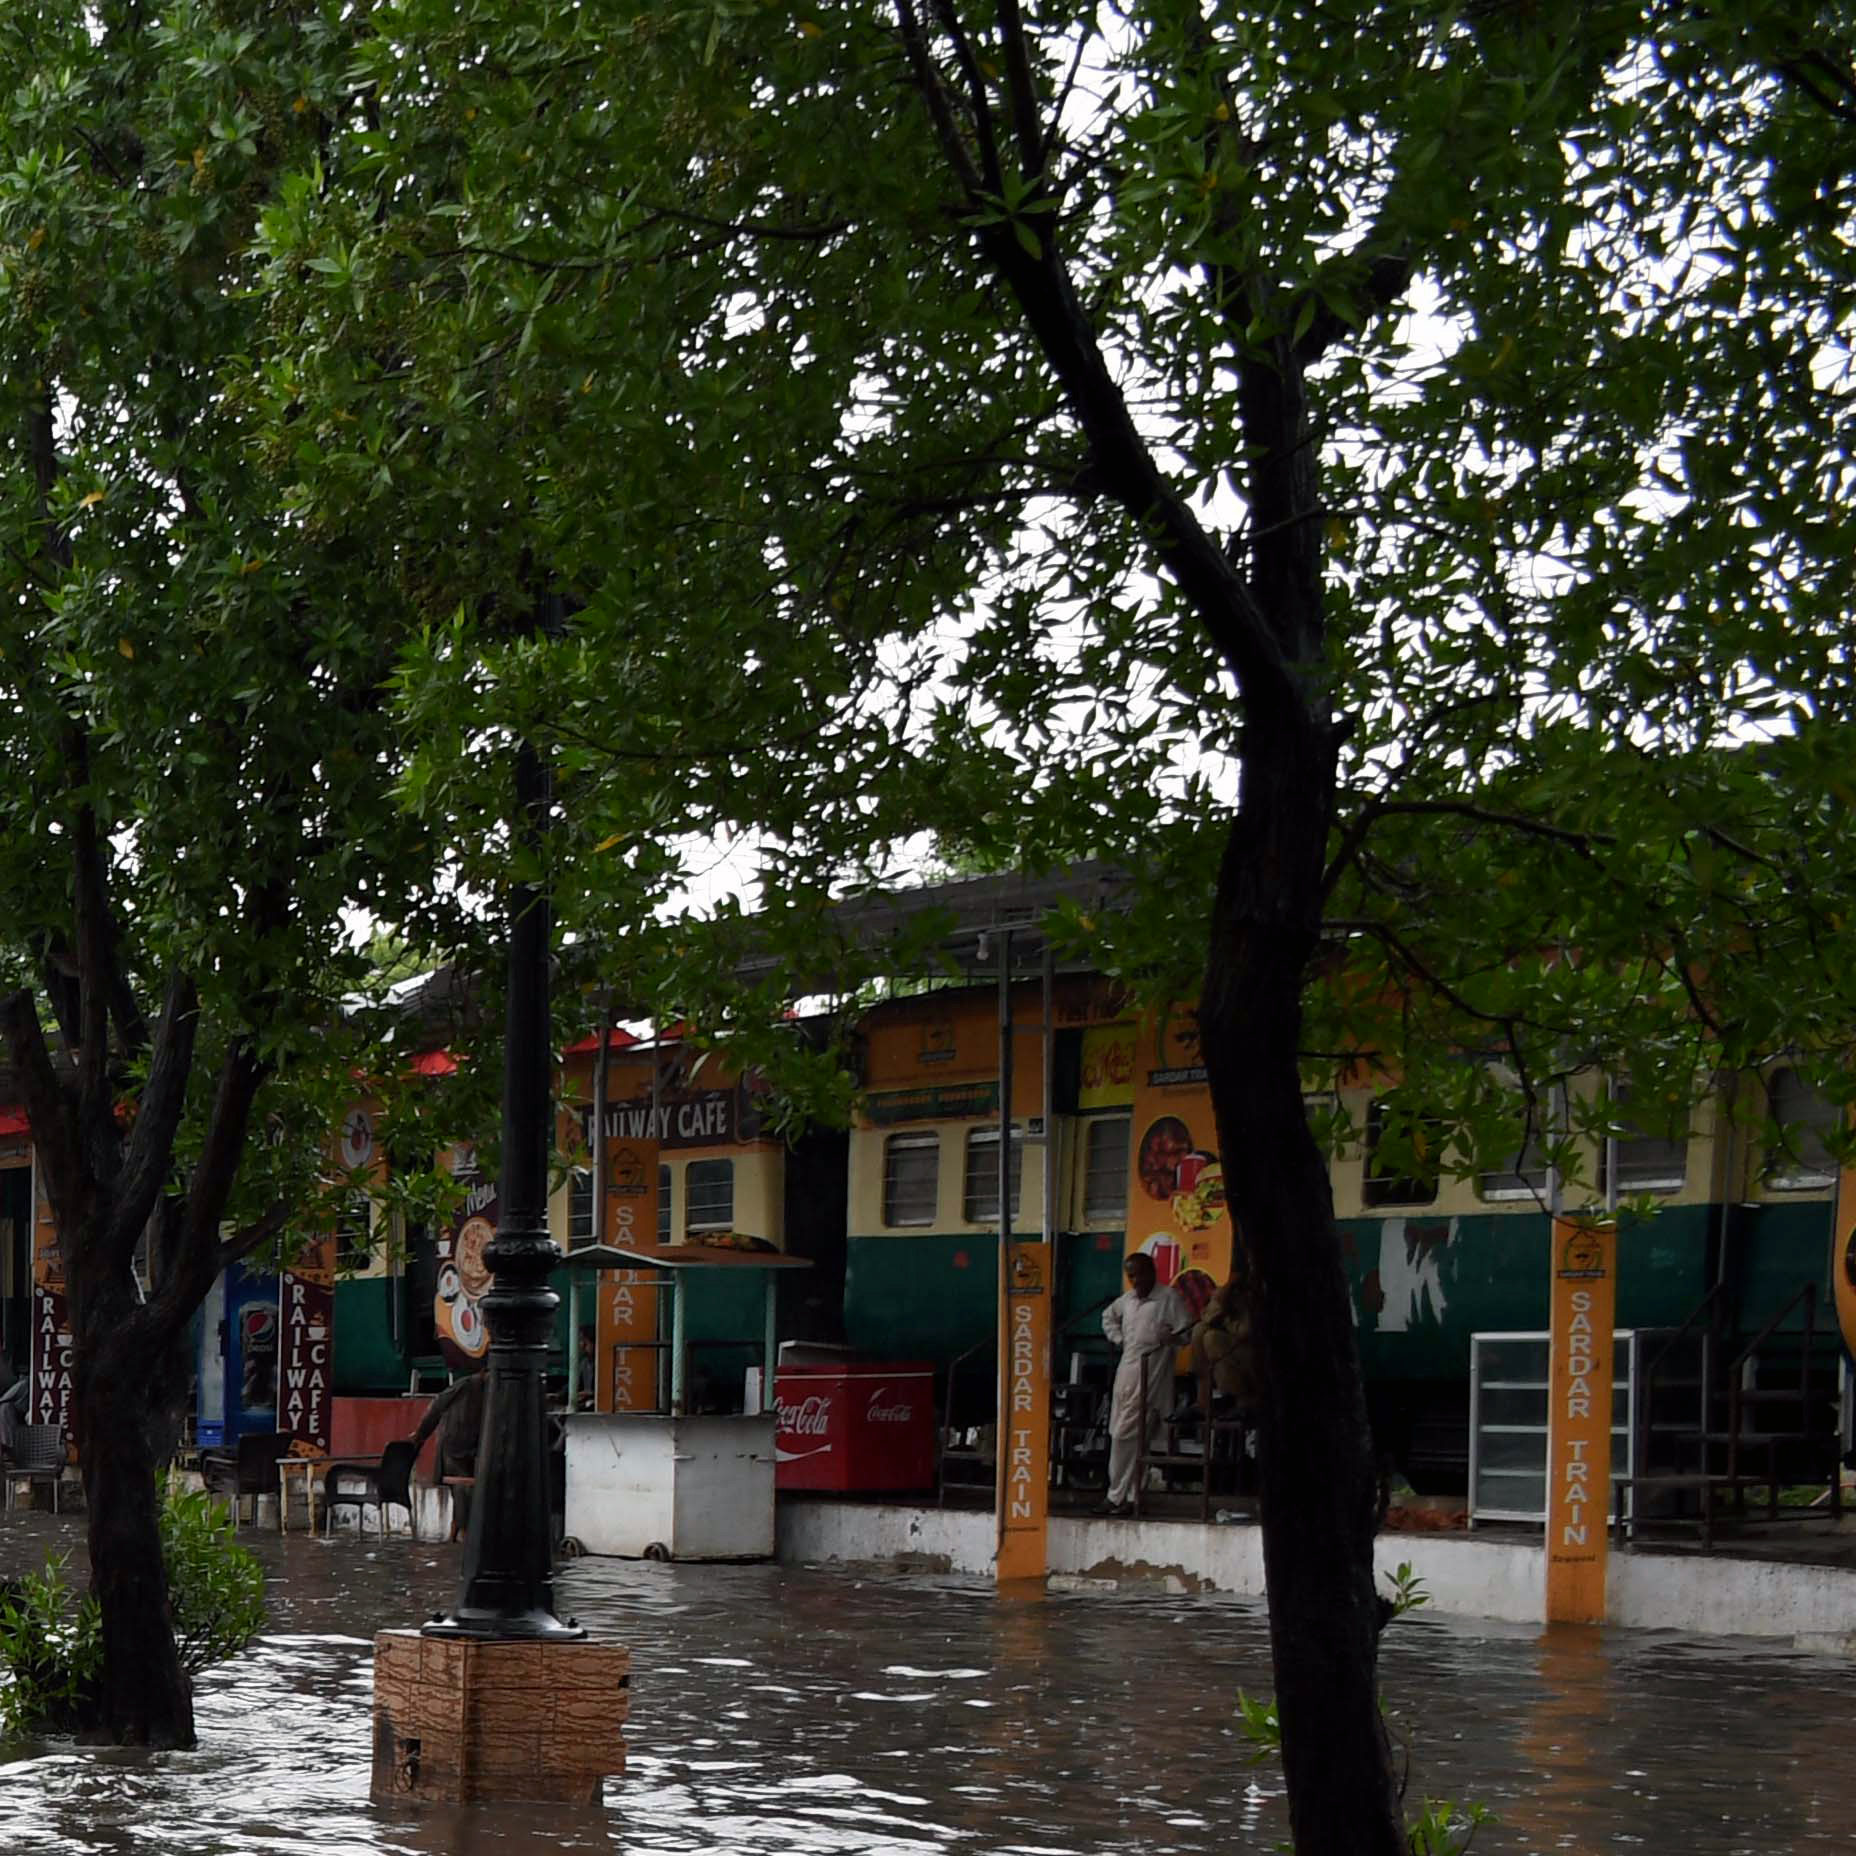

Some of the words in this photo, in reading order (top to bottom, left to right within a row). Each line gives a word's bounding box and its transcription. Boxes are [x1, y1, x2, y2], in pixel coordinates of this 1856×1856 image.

[612, 1206, 635, 1326] SADAR
[38, 1296, 56, 1426] RAILWAY
[286, 1284, 307, 1431] RAILWAY
[308, 1344, 325, 1434] CAFÉ
[1014, 1305, 1033, 1412] SARDAR
[1567, 1291, 1593, 1419] SARDAR
[1011, 1430, 1032, 1519] TRAIN
[1563, 1440, 1588, 1546] TRAIN
